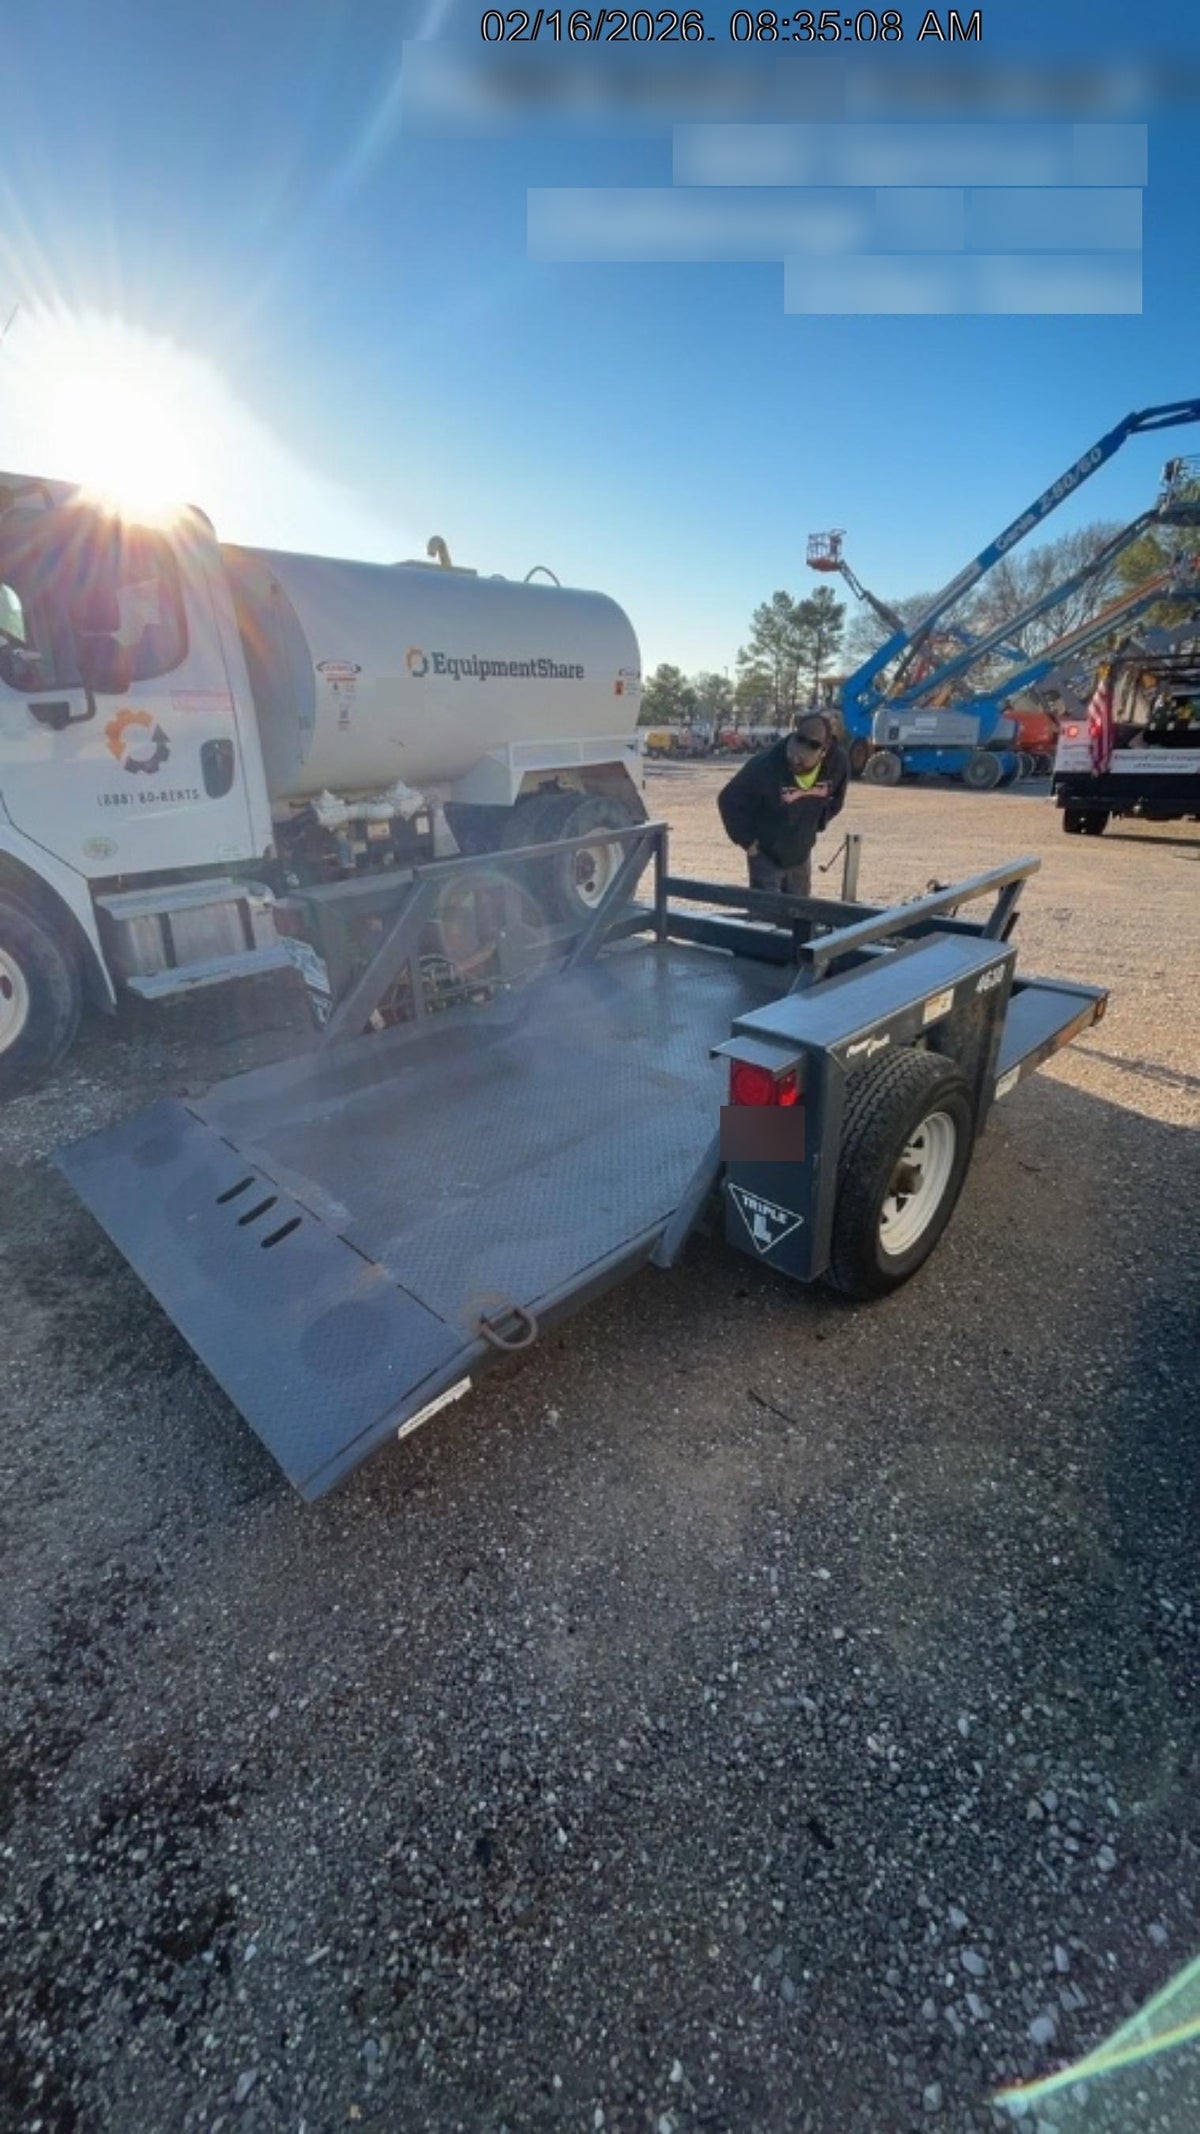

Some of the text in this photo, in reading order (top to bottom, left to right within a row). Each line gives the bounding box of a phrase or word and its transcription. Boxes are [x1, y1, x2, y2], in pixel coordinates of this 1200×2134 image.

[431, 651, 585, 682] EquipmentShare
[741, 1194, 787, 1225] TRIPLE
[753, 1212, 772, 1244] L
